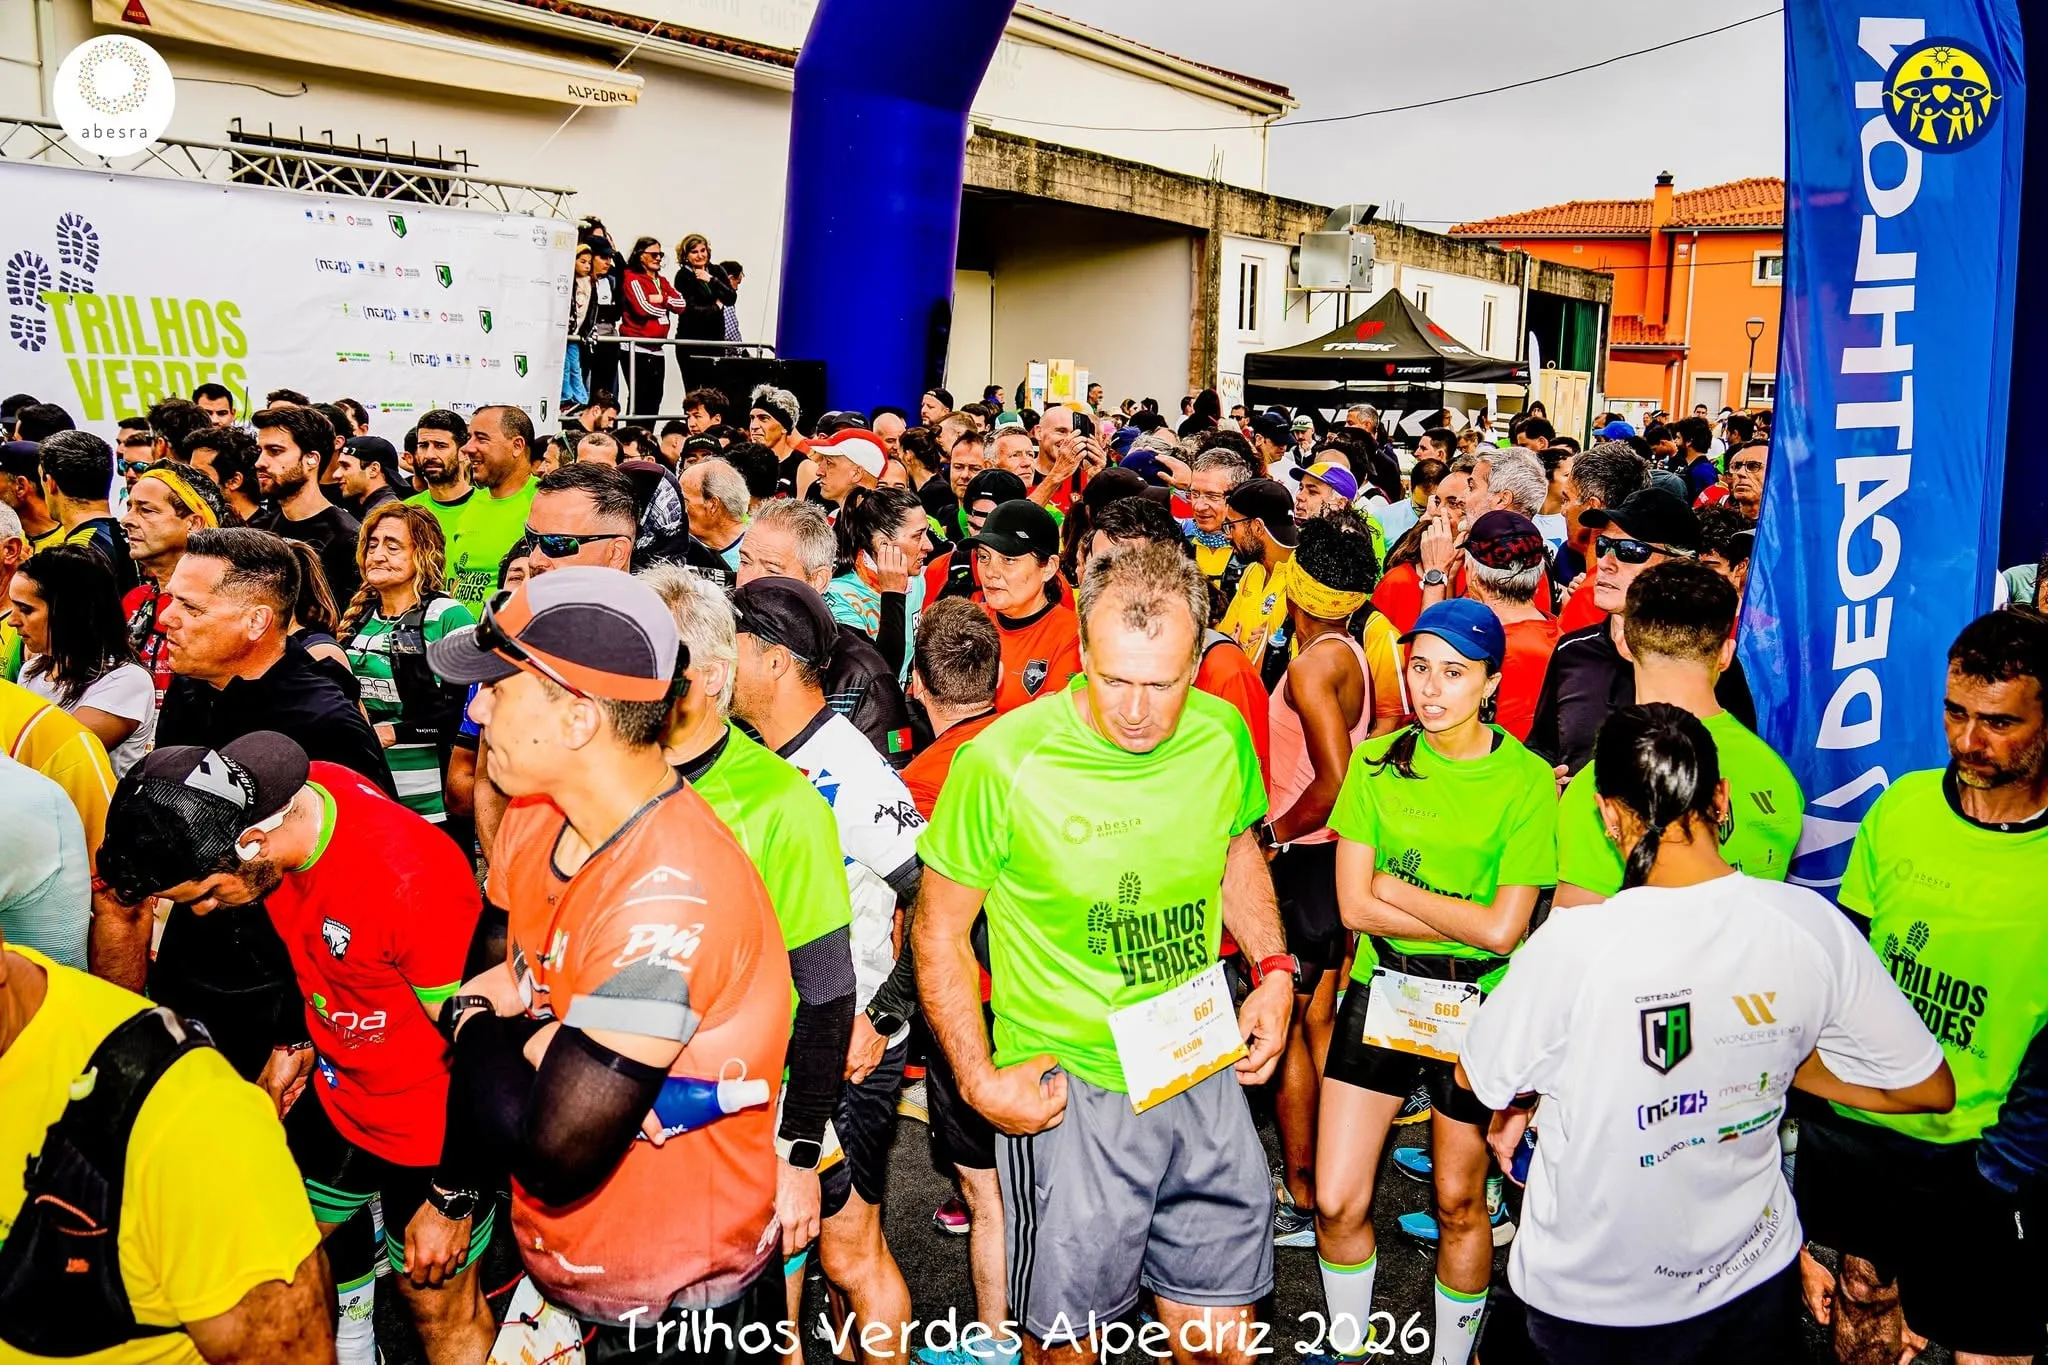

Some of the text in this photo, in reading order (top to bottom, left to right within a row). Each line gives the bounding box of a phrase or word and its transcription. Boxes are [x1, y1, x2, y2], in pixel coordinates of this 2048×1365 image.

[127, 9, 146, 19] DELTA
[567, 84, 633, 103] ALPEDRIZ
[41, 291, 248, 360] TRILHOS
[1322, 342, 1397, 352] TREK
[1396, 365, 1432, 375] TREK
[1096, 817, 1142, 832] abesra
[1914, 871, 1951, 889] abesra
[1107, 898, 1207, 953] TRILHOS
[1116, 933, 1208, 988] VERDES
[1889, 952, 1989, 1018] TRILHOS
[1634, 987, 1693, 1004] CISTERAUTO
[1193, 997, 1215, 1022] 667
[1434, 1002, 1460, 1018] 668
[1408, 1018, 1439, 1034] SANTOS
[1714, 1030, 1765, 1046] WONDER
[1173, 1035, 1204, 1060] NELSON
[1725, 1248, 1761, 1276] cuidar
[1761, 1208, 1780, 1250] melhor
[1654, 1264, 1692, 1279] Mover
[1695, 1267, 1703, 1276] a
